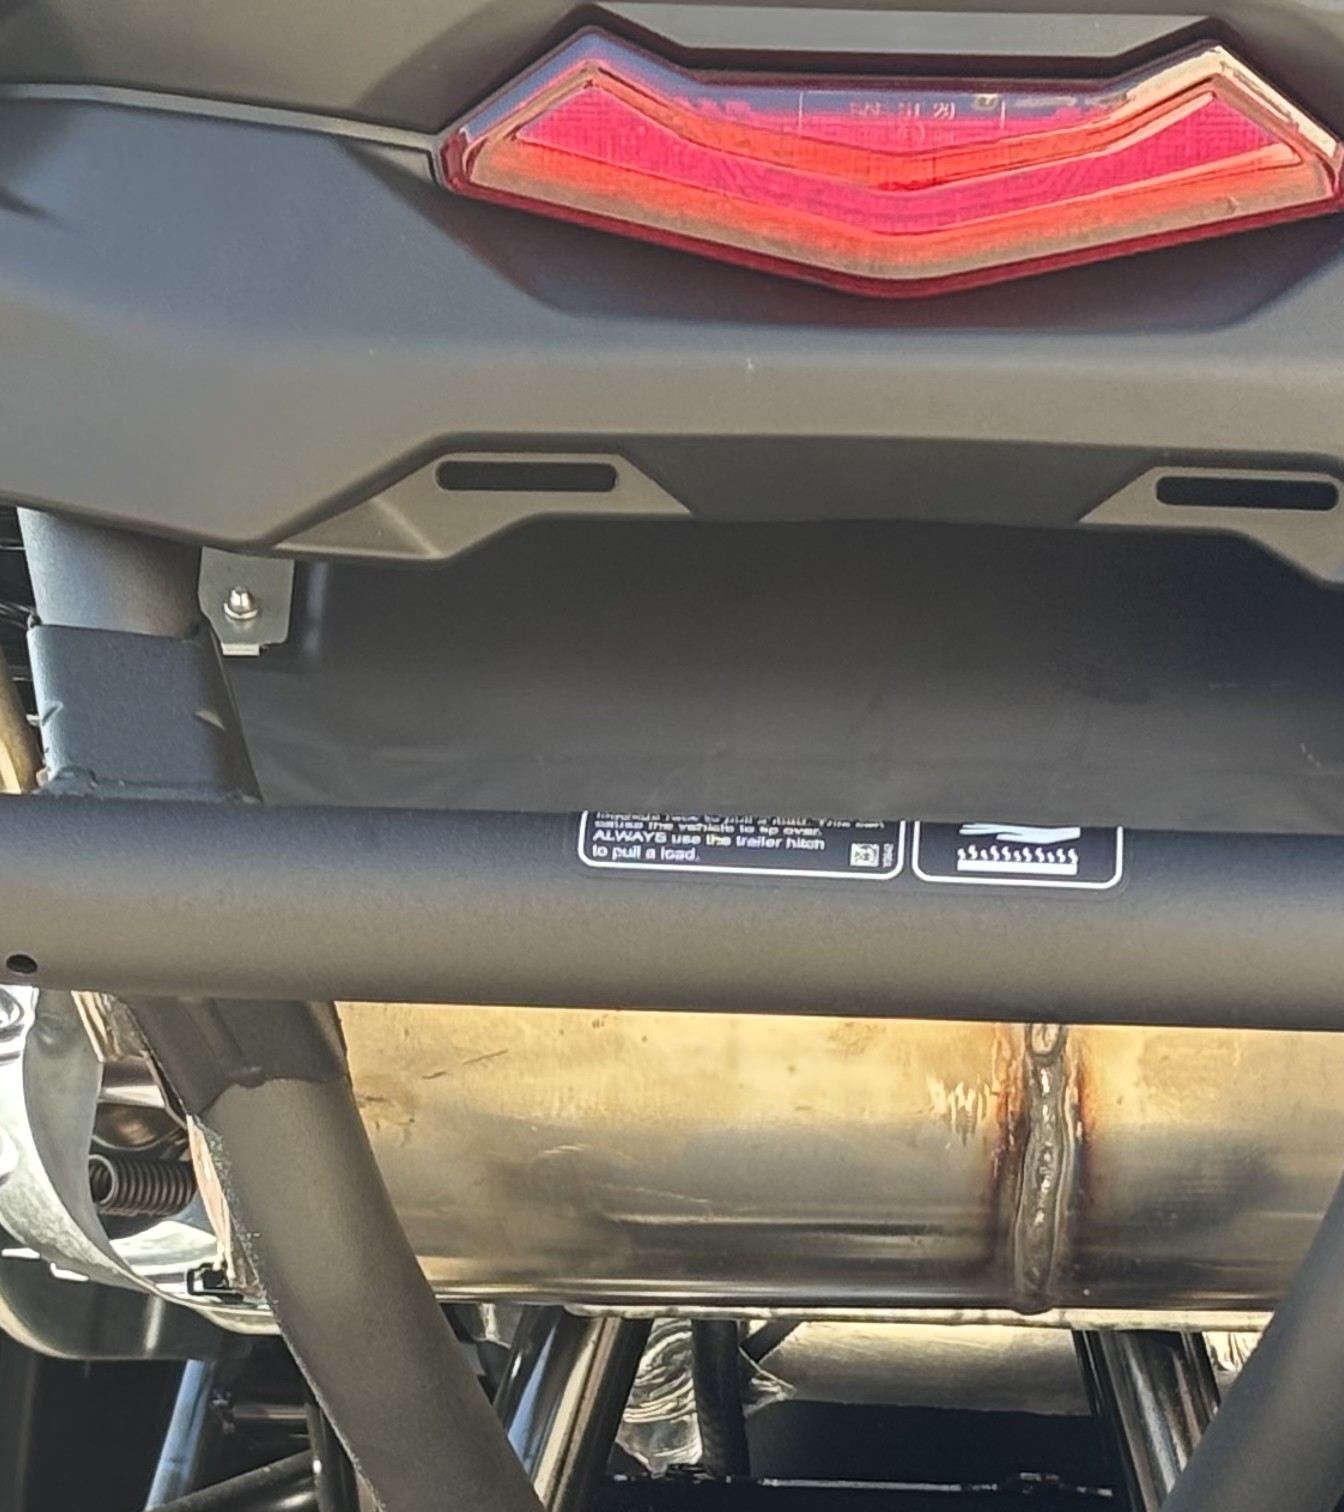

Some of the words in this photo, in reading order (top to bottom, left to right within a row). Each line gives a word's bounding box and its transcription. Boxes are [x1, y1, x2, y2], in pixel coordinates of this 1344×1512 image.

[648, 821, 674, 831] the
[678, 822, 735, 833] vehicle
[739, 824, 755, 834] to
[592, 829, 667, 844] ALWAYS
[671, 833, 702, 845] use
[705, 833, 732, 846] the
[736, 834, 784, 848] trailer
[785, 836, 826, 850] hitch
[592, 843, 609, 858] to
[611, 844, 642, 861] pull
[645, 847, 657, 860] a
[660, 845, 701, 862] load.
